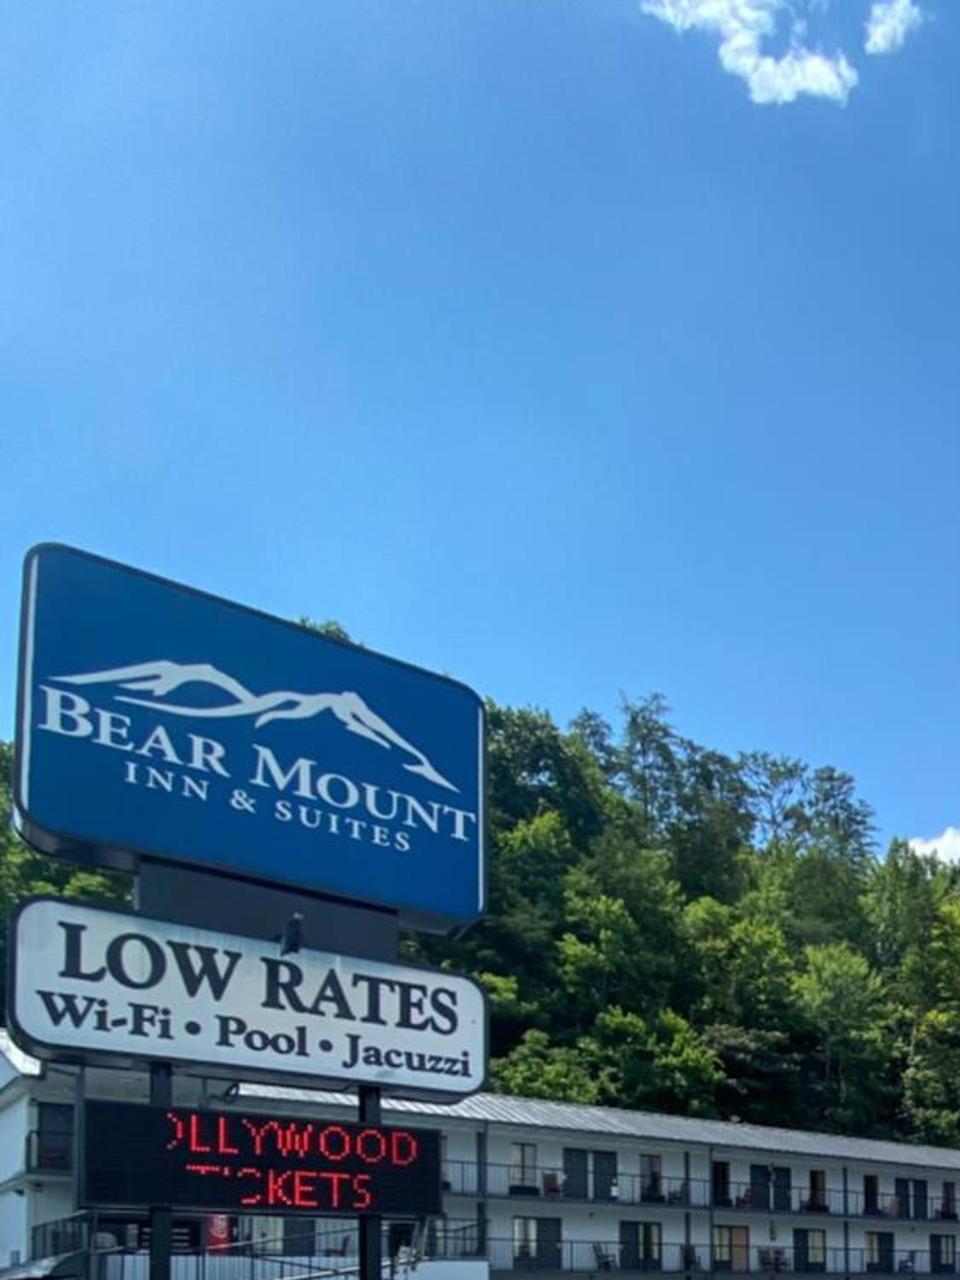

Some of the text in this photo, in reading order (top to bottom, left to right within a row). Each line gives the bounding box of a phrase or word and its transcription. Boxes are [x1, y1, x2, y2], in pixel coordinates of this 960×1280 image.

[38, 684, 476, 842] BEAR MOUNT
[124, 762, 411, 852] INN & SUITES
[57, 921, 459, 1035] LOW RATES
[215, 1014, 310, 1057] Pool
[342, 1033, 472, 1079] Jacuzzi
